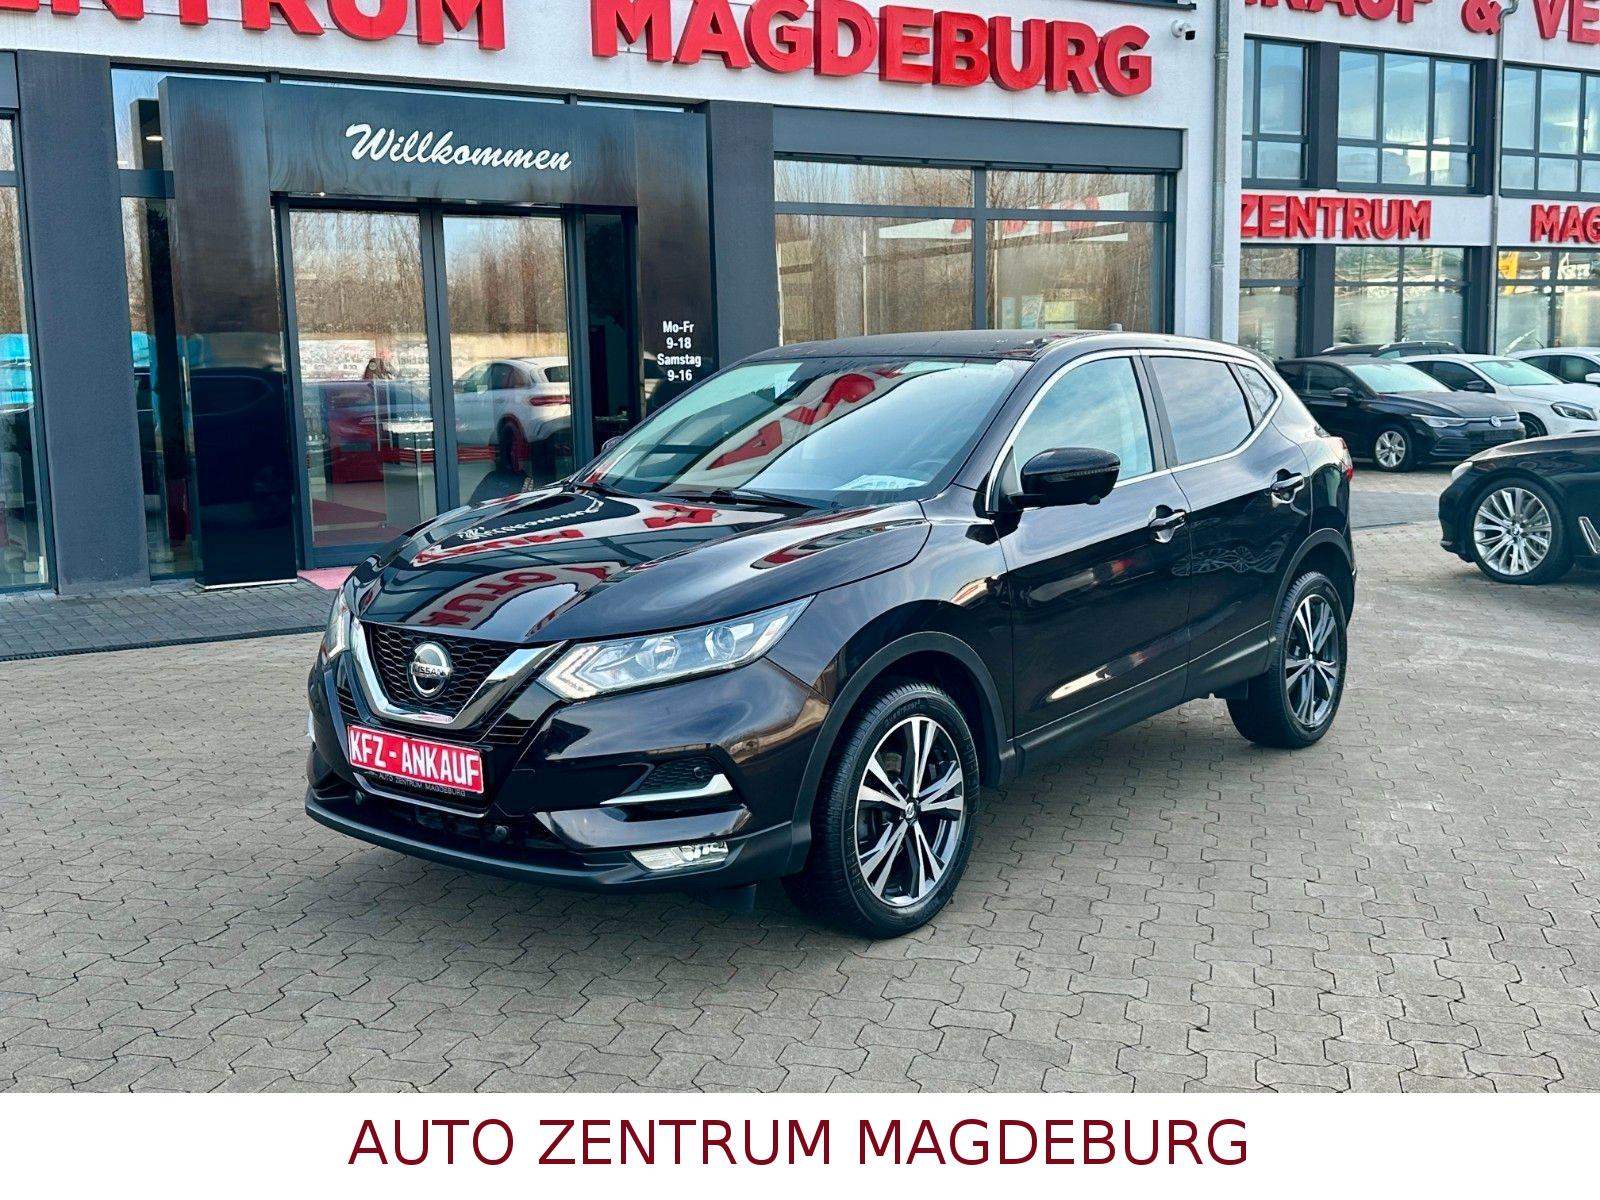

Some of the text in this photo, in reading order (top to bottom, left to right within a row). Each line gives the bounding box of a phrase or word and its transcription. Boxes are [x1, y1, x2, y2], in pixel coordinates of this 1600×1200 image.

[590, 0, 1152, 96] MAGDEBURG
[345, 123, 572, 171] Willkommen
[1240, 194, 1432, 240] ZENTRUM
[662, 320, 695, 333] Mo-Fr
[666, 336, 692, 349] 9-18
[657, 352, 702, 368] Samstag
[667, 369, 693, 382] 9-16
